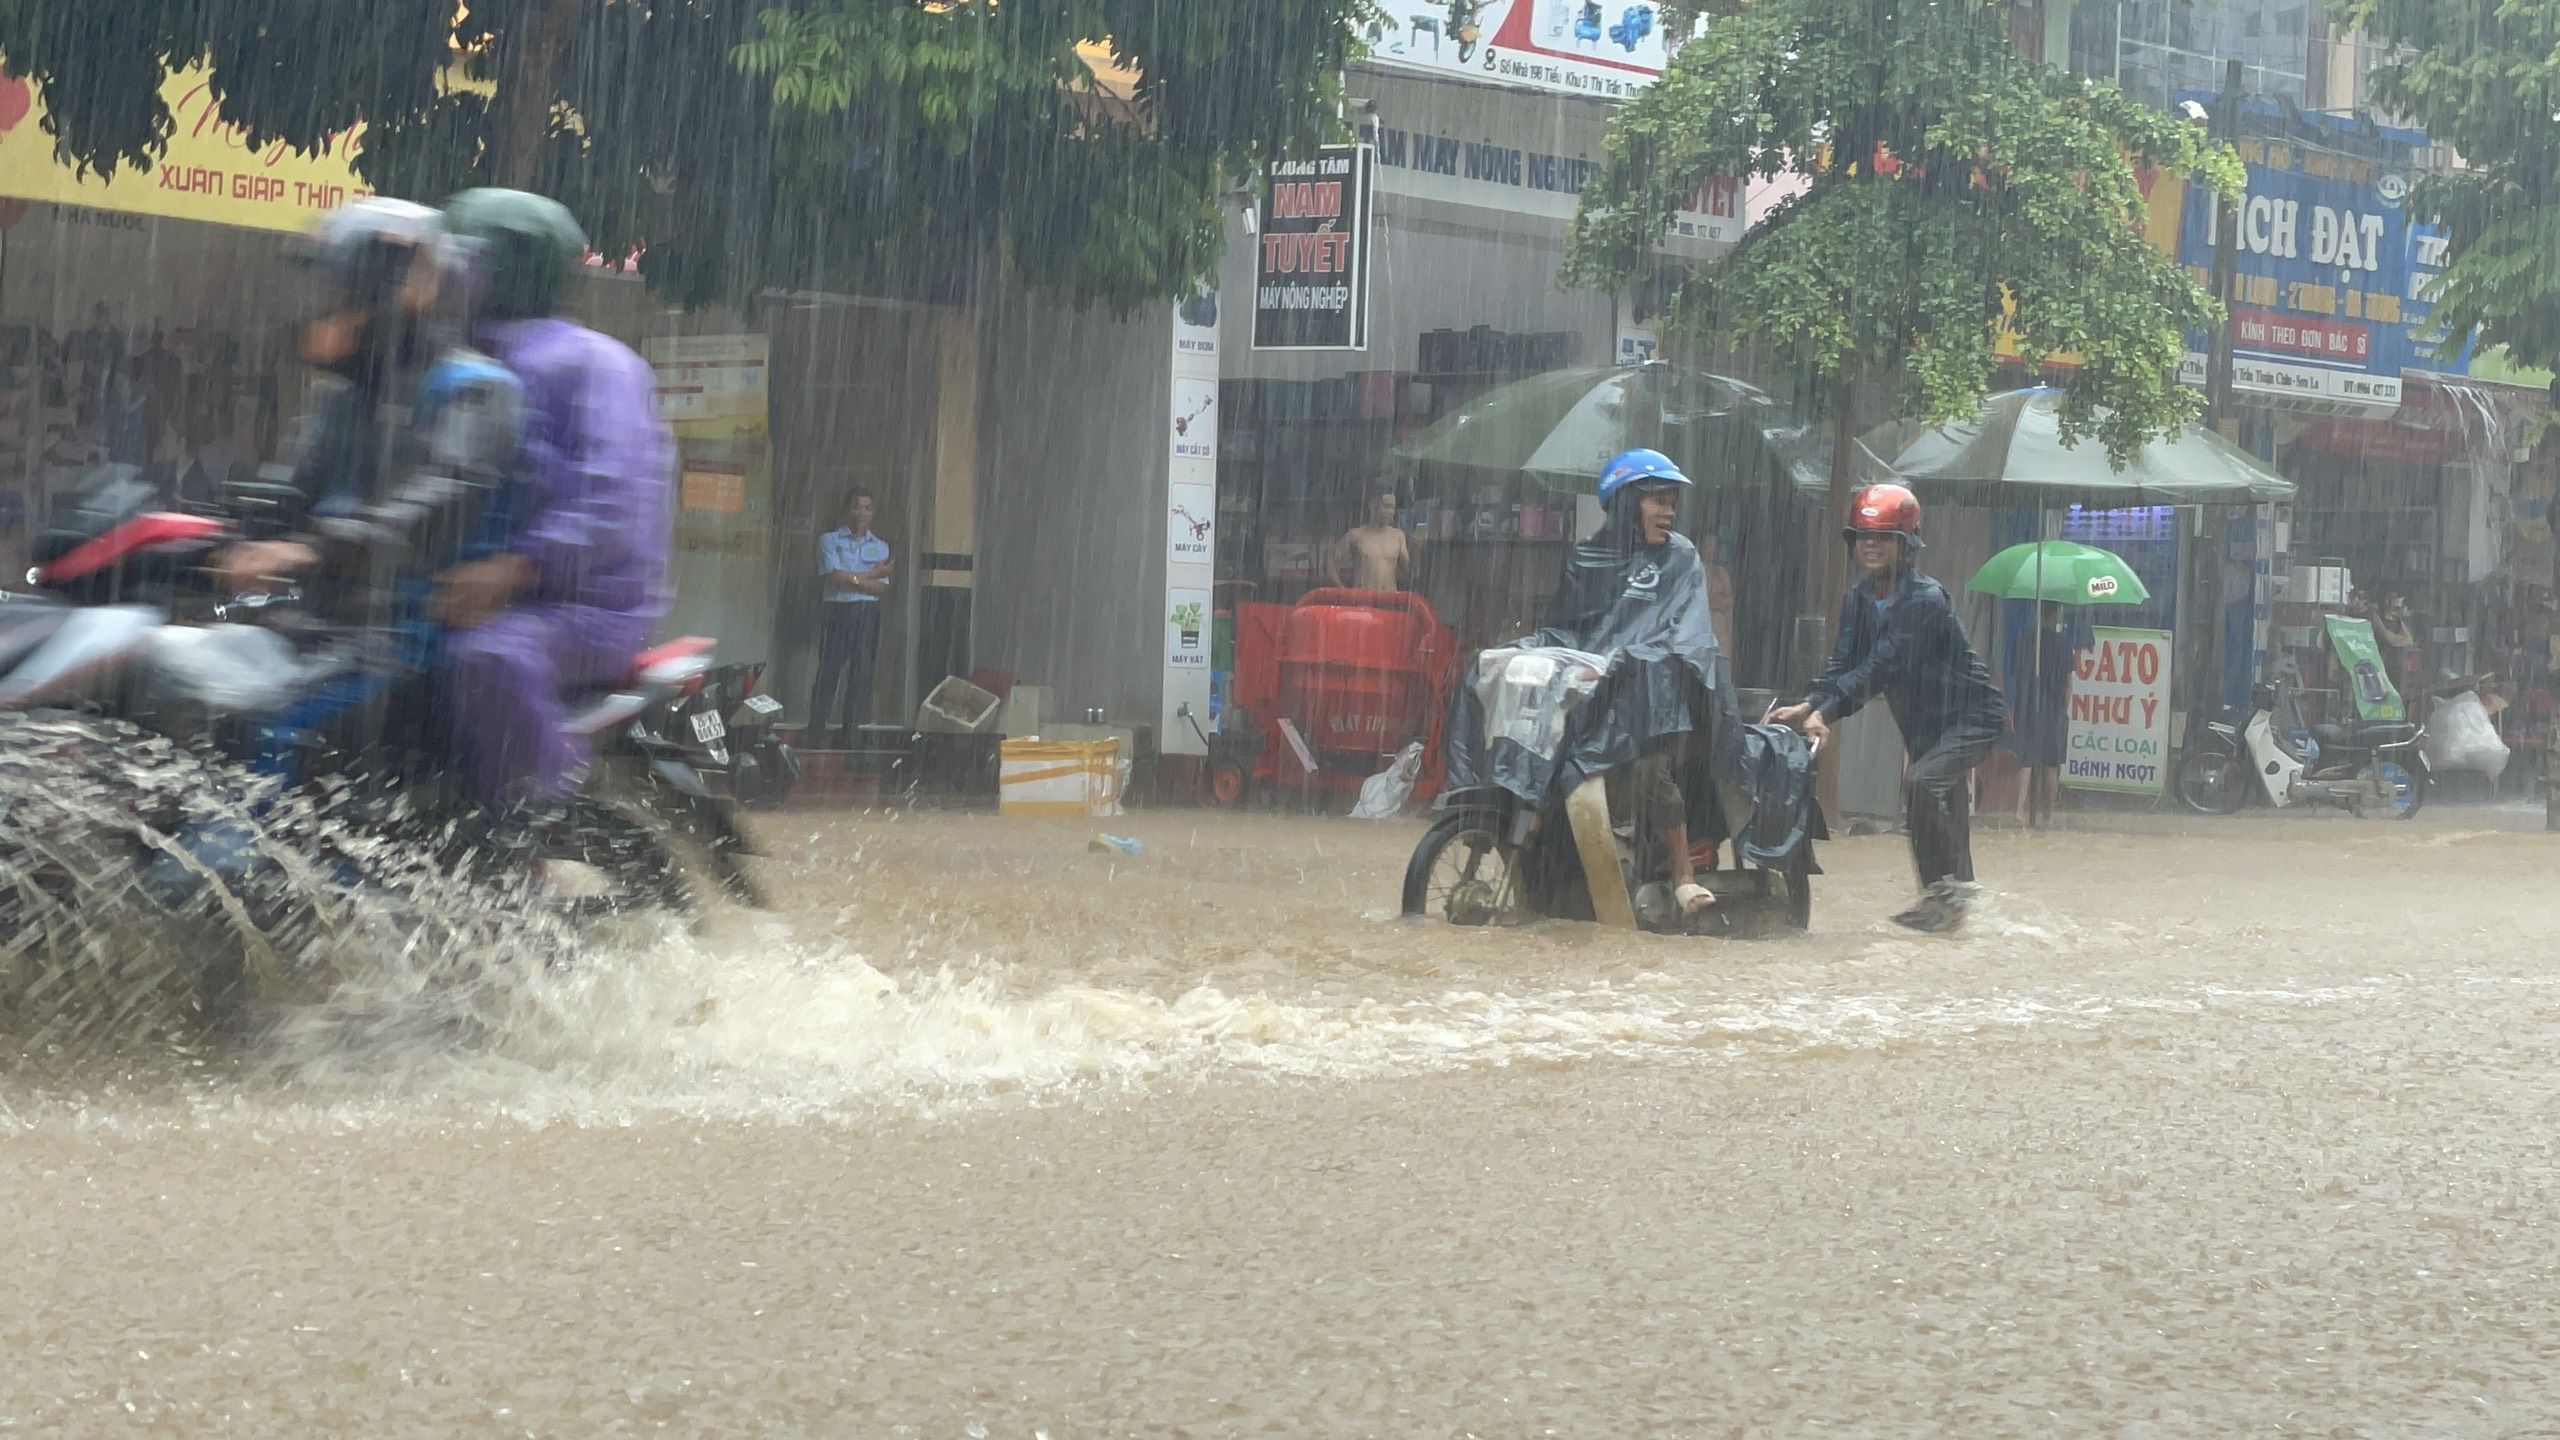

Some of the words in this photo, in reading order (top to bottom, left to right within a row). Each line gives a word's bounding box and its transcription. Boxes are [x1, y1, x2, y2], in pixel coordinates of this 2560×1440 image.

[1565, 71, 1581, 88] Khu
[1582, 75, 1588, 88] 3
[1319, 156, 1350, 175] TÂM
[1412, 129, 1460, 175] MÁY
[1464, 137, 1522, 186] NÔNG
[159, 163, 224, 196] XUÂN
[232, 172, 285, 202] GIÁP
[1273, 181, 1342, 218] NAM
[1263, 218, 1351, 273] TUYẾT
[2311, 204, 2384, 283] ĐẠT
[1259, 280, 1282, 310] MÁY
[1281, 281, 1311, 310] NÔNG
[1310, 279, 1349, 314] NGHIỆP
[2241, 320, 2265, 341] KÍNH
[2271, 325, 2296, 346] THEO
[2329, 330, 2348, 353] BÁC
[1175, 542, 1192, 552] MÁY
[2091, 581, 2115, 593] MILO
[1171, 654, 1189, 663] MÁY
[2074, 639, 2160, 686] GATO
[2071, 694, 2134, 726] NHƯ
[2140, 691, 2160, 730] Ý
[2071, 731, 2109, 752] CÁC
[2115, 737, 2158, 760] LOẠI
[2069, 756, 2110, 779] BÁNH
[2115, 763, 2157, 785] NGỌT
